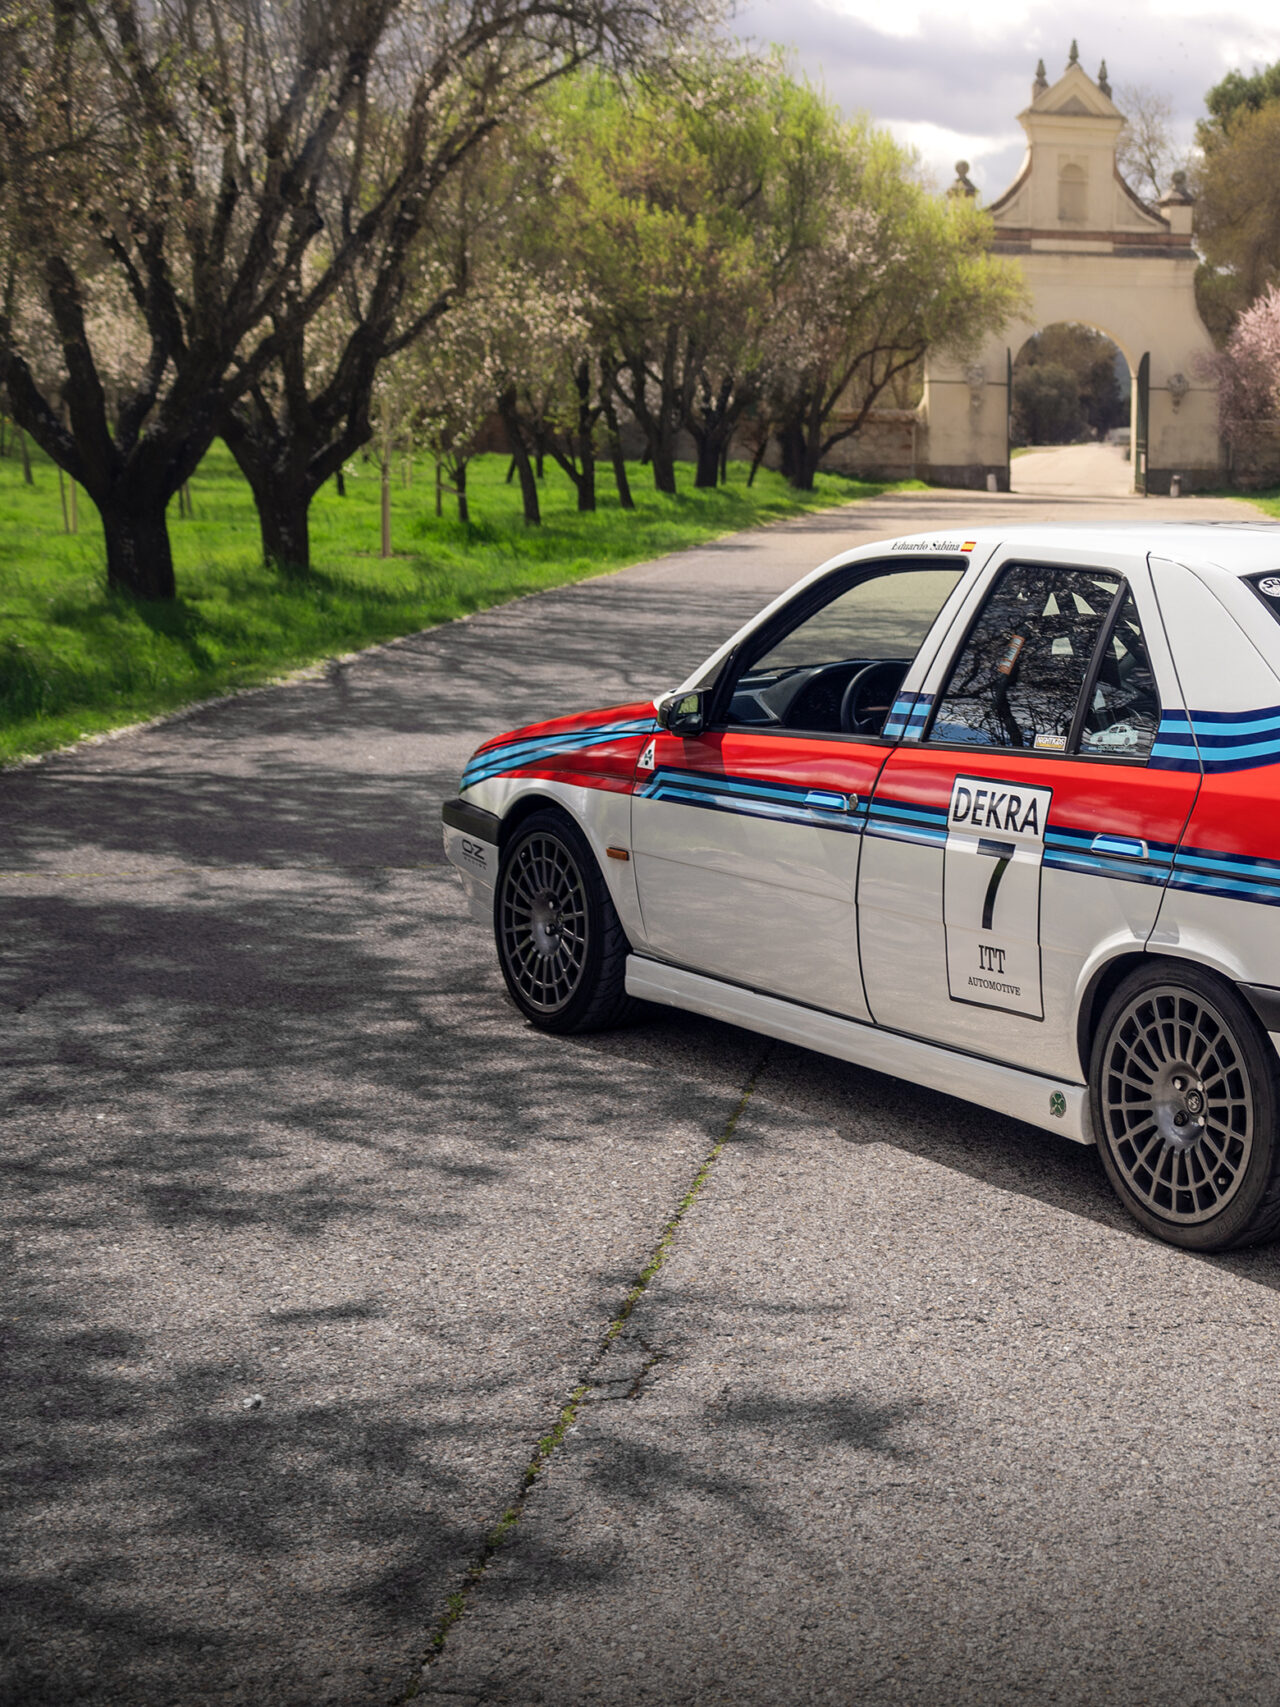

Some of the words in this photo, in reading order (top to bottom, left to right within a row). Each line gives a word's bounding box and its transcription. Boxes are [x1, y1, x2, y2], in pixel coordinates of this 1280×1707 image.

[952, 786, 1039, 835] DEKRA
[976, 838, 1016, 931] 7
[978, 944, 1006, 975] ITT
[968, 976, 1021, 996] AUTOMOTIVE
